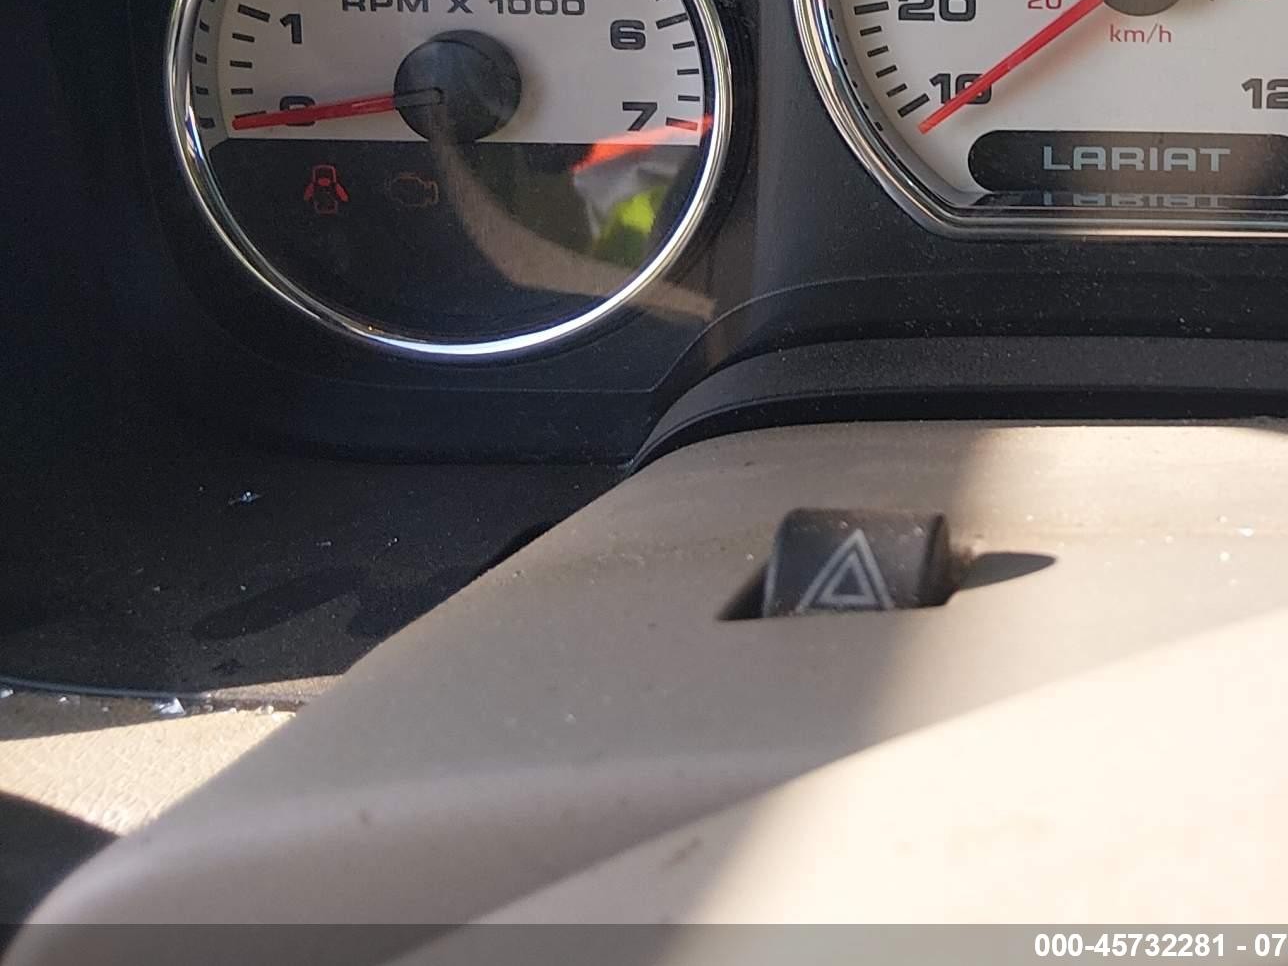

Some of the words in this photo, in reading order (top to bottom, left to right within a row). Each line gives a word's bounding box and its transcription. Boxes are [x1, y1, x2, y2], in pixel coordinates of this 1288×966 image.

[279, 13, 303, 45] 1
[609, 19, 646, 51] 6
[1108, 23, 1173, 44] km/h
[929, 73, 992, 105] 10
[621, 101, 658, 132] 7
[1044, 146, 1232, 172] LARIAT
